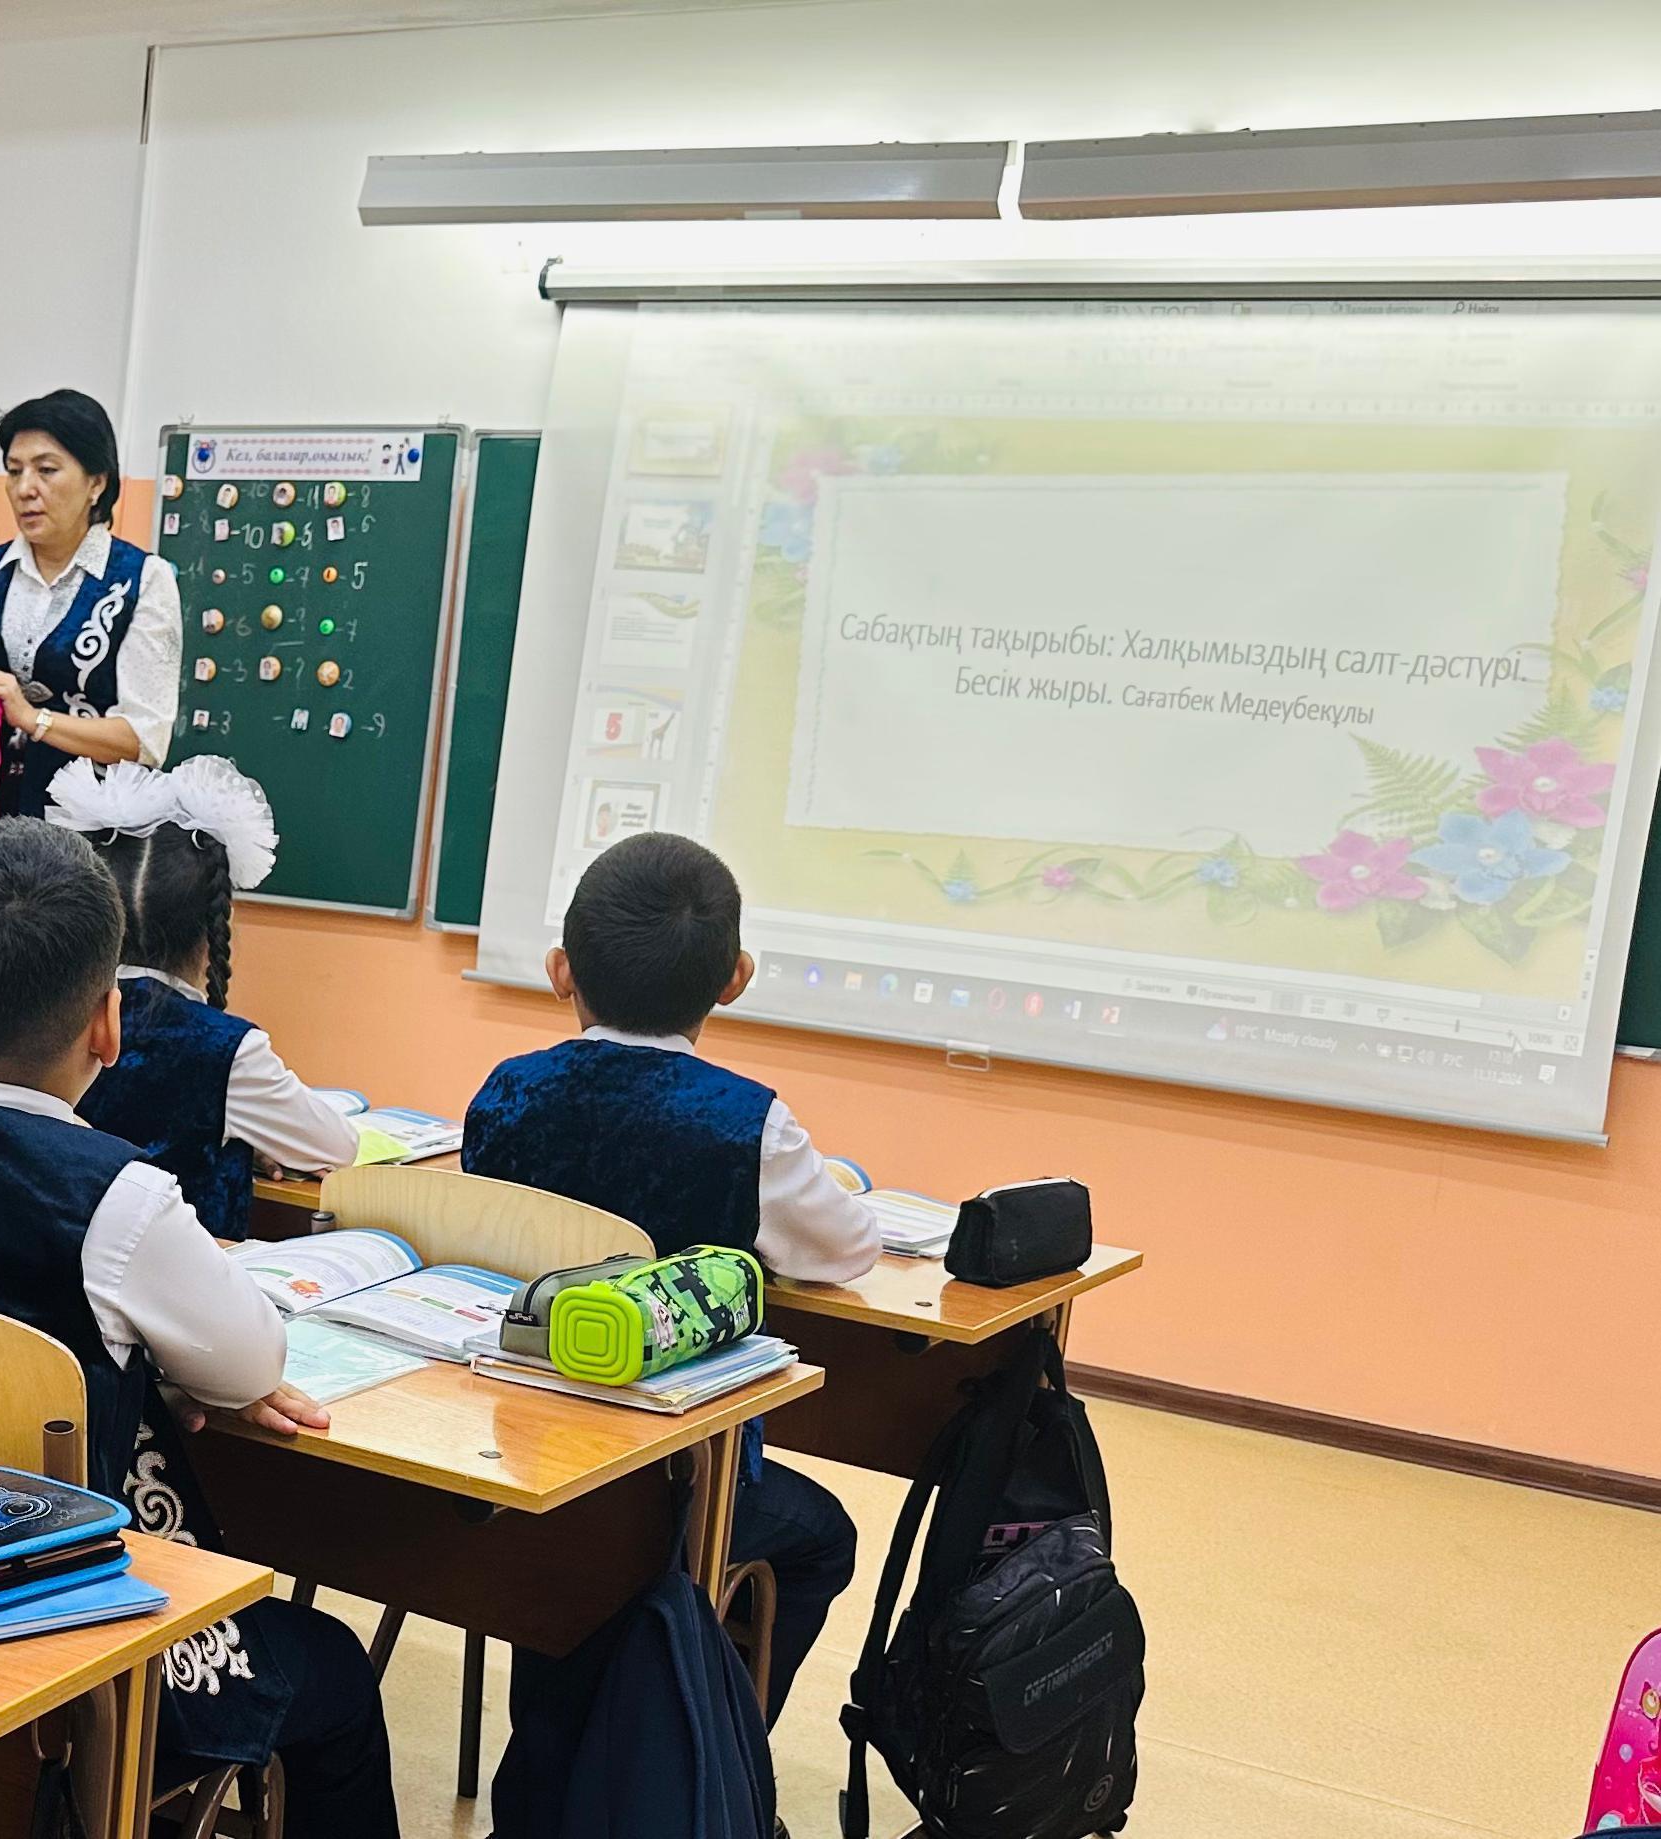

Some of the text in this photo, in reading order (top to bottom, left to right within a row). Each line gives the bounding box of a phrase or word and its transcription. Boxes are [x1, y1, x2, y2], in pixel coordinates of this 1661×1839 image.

[840, 612, 1528, 688] Сабақтың тақырыбы: Халқымыздың салт-дәстүрі.
[955, 666, 1374, 728] Бесік жыры. Сағатбек Медеубекұлы
[1264, 1028, 1300, 1048] Mostly
[1301, 1032, 1338, 1053] cloudy
